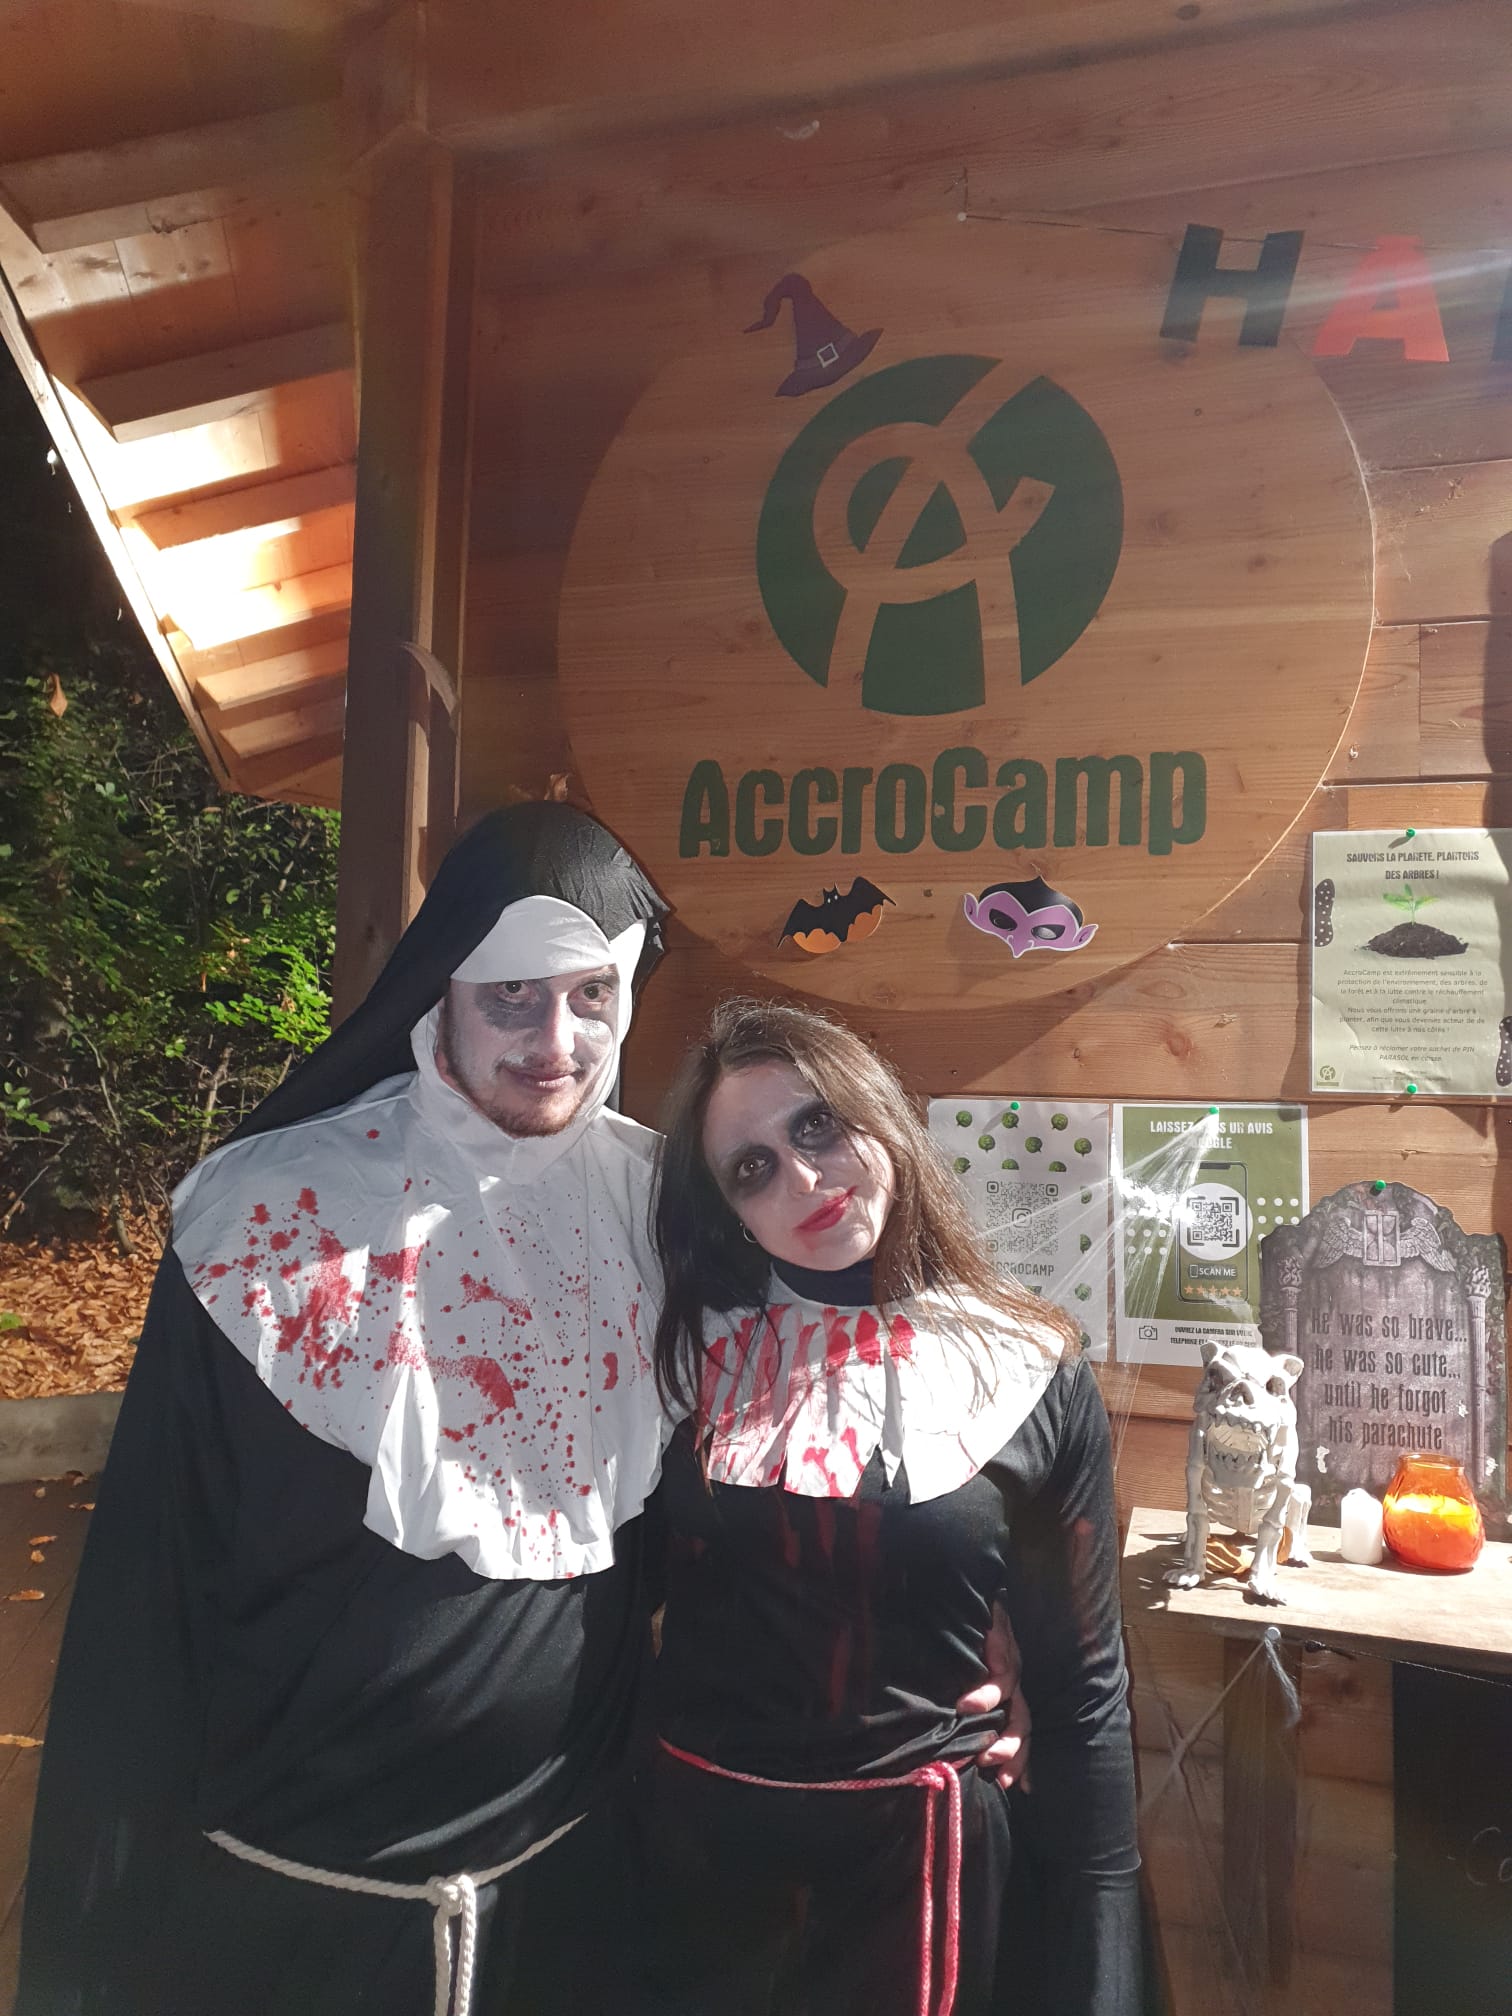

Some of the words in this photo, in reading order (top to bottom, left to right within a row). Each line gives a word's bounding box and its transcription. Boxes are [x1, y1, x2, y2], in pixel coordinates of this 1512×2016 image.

[1159, 224, 1512, 363] HA
[679, 747, 1207, 858] AccroCamp
[1386, 853, 1397, 862] LA
[1437, 851, 1480, 861] PLANTONS
[1385, 870, 1400, 879] DES
[1403, 869, 1434, 879] ARBRES
[1248, 1122, 1273, 1134] AVIS
[1199, 1266, 1222, 1276] SCAN
[1223, 1268, 1236, 1277] ME
[1311, 1308, 1330, 1335] He
[1340, 1313, 1373, 1337] was
[1382, 1315, 1400, 1339] so
[1409, 1313, 1468, 1343] brave...
[1315, 1344, 1333, 1373] he
[1343, 1349, 1376, 1374] was
[1385, 1351, 1403, 1375] so
[1412, 1352, 1461, 1379] cute...
[1324, 1381, 1361, 1408] until
[1371, 1383, 1389, 1412] he
[1398, 1383, 1447, 1417] forgot
[1329, 1416, 1353, 1444] his
[1361, 1421, 1443, 1450] parachute
